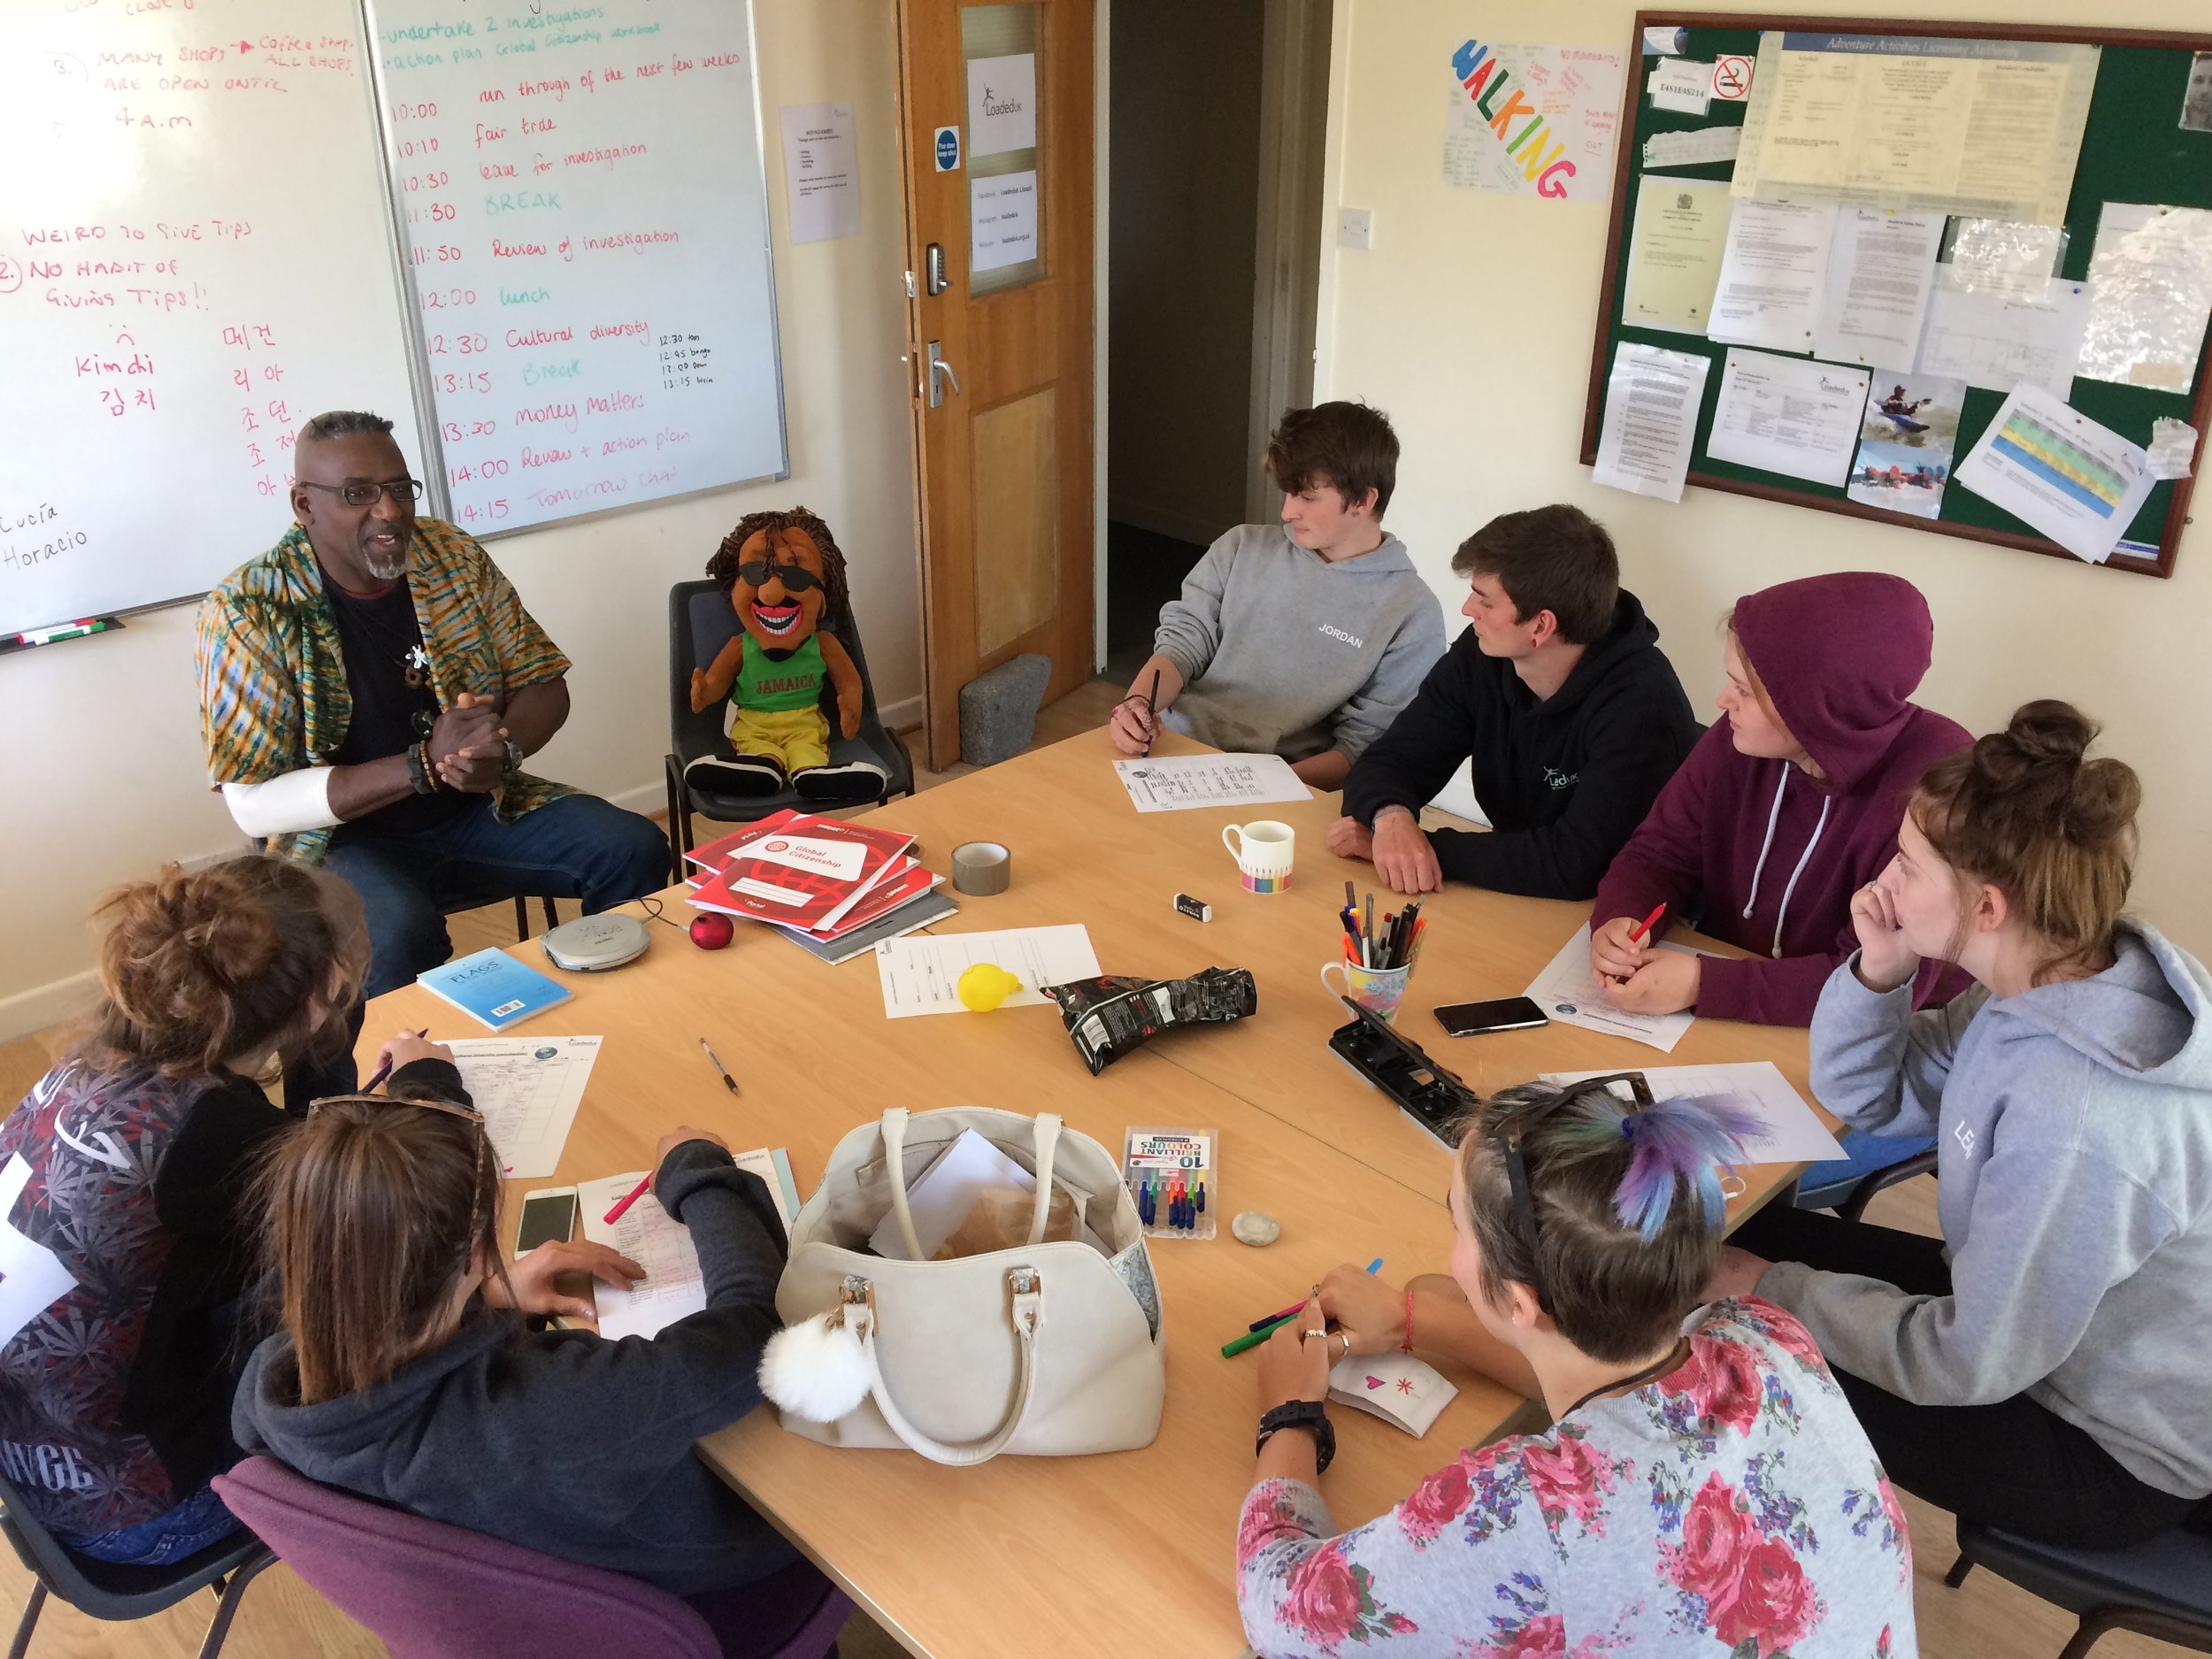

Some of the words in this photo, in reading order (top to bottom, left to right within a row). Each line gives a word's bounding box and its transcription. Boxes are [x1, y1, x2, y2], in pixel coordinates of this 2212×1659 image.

[388, 24, 474, 43] undertake
[487, 16, 498, 32] 2
[452, 47, 482, 63] plan
[1826, 37, 1874, 50] Adventure
[98, 52, 162, 66] MANY
[179, 47, 225, 63] SHOPS
[104, 77, 142, 91] ARE
[159, 75, 209, 90] OPEN
[390, 103, 438, 122] 10:00
[480, 88, 505, 103] run
[518, 77, 570, 102] through
[580, 70, 596, 94] of
[604, 66, 626, 82] the
[636, 62, 664, 79] next
[671, 53, 693, 74] few
[702, 52, 740, 68] weeks
[115, 107, 134, 126] 4
[1451, 39, 1577, 199] WALKING
[397, 137, 440, 159] 10:10
[475, 122, 508, 149] fair
[403, 172, 449, 192] 10:30
[533, 152, 553, 176] for
[564, 142, 647, 171] investigation
[408, 204, 456, 225] 11:30
[484, 193, 562, 218] BREAK
[21, 227, 106, 247] WEIRD
[413, 245, 462, 265] 11:50
[491, 239, 548, 259] Review
[558, 235, 574, 264] of
[583, 230, 680, 256] investigation
[30, 261, 62, 279] NO
[420, 288, 477, 310] 12:00
[427, 334, 488, 356] 12:30
[505, 328, 573, 350] Cultural
[589, 319, 651, 348] diversity
[659, 334, 683, 347] 12:30
[234, 364, 284, 392] 리아
[434, 372, 492, 394] 13:15
[522, 359, 581, 386] Break
[99, 388, 156, 417] 김치
[241, 400, 291, 432] 조던
[442, 420, 496, 442] 13:30
[450, 460, 510, 488] 14:00
[602, 437, 648, 456] action
[656, 426, 690, 450] plan
[457, 499, 510, 524] 14:15
[4, 531, 88, 571] Horacio
[1318, 623, 1363, 649] JORDAN
[756, 673, 816, 695] JAMAICA
[788, 850, 843, 869] Citizenship
[795, 844, 827, 858] Global
[449, 961, 500, 983] FLAGS
[1141, 1141, 1202, 1150] COLOURS
[1179, 1156, 1204, 1168] 10
